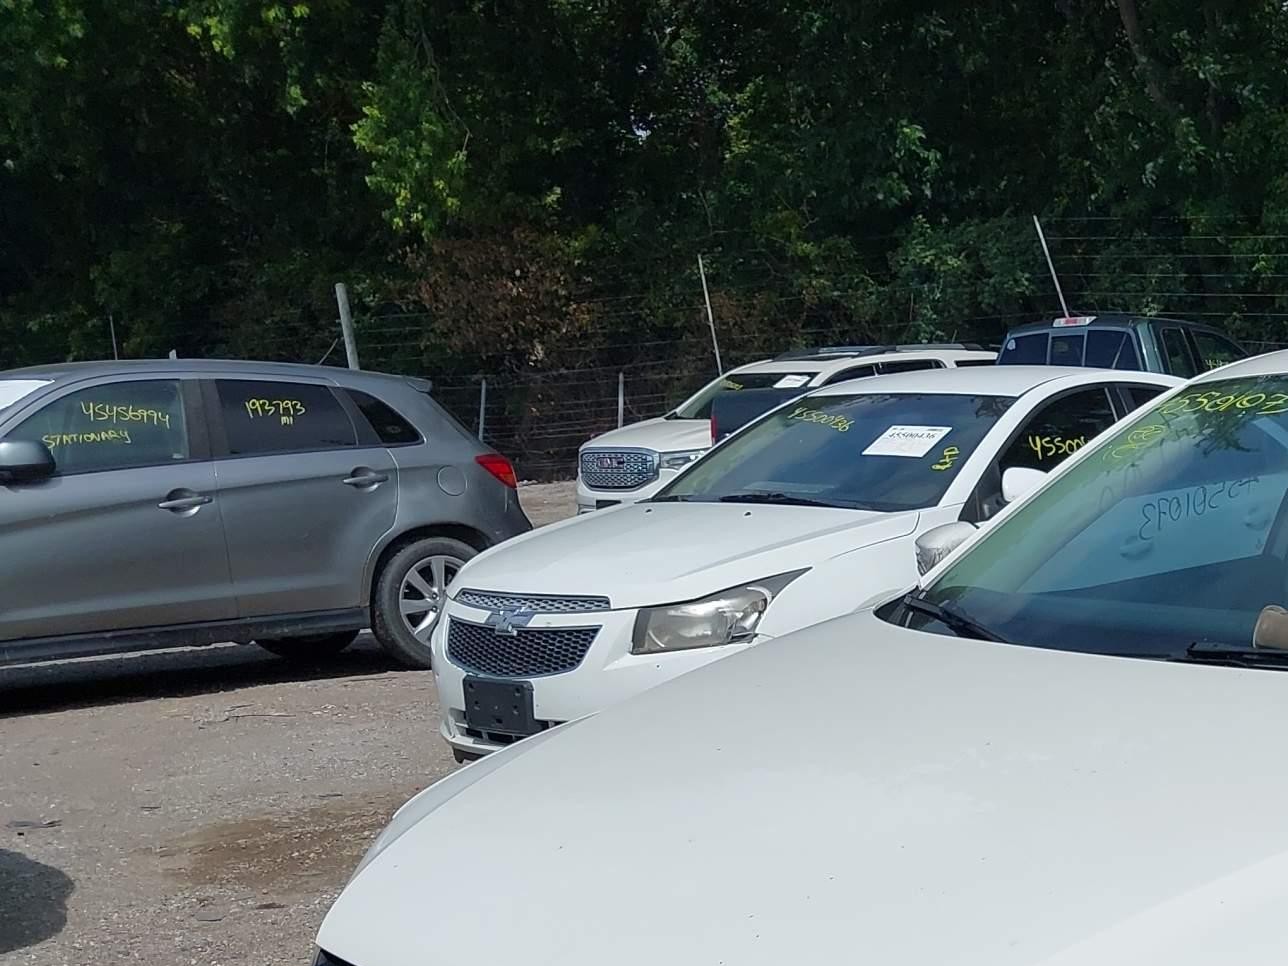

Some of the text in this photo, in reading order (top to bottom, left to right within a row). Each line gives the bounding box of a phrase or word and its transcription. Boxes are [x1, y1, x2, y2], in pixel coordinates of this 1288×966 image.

[80, 401, 170, 429] 45456994
[245, 399, 306, 418] 193793
[41, 430, 132, 449] STATIONARY
[1029, 435, 1089, 460] 45500
